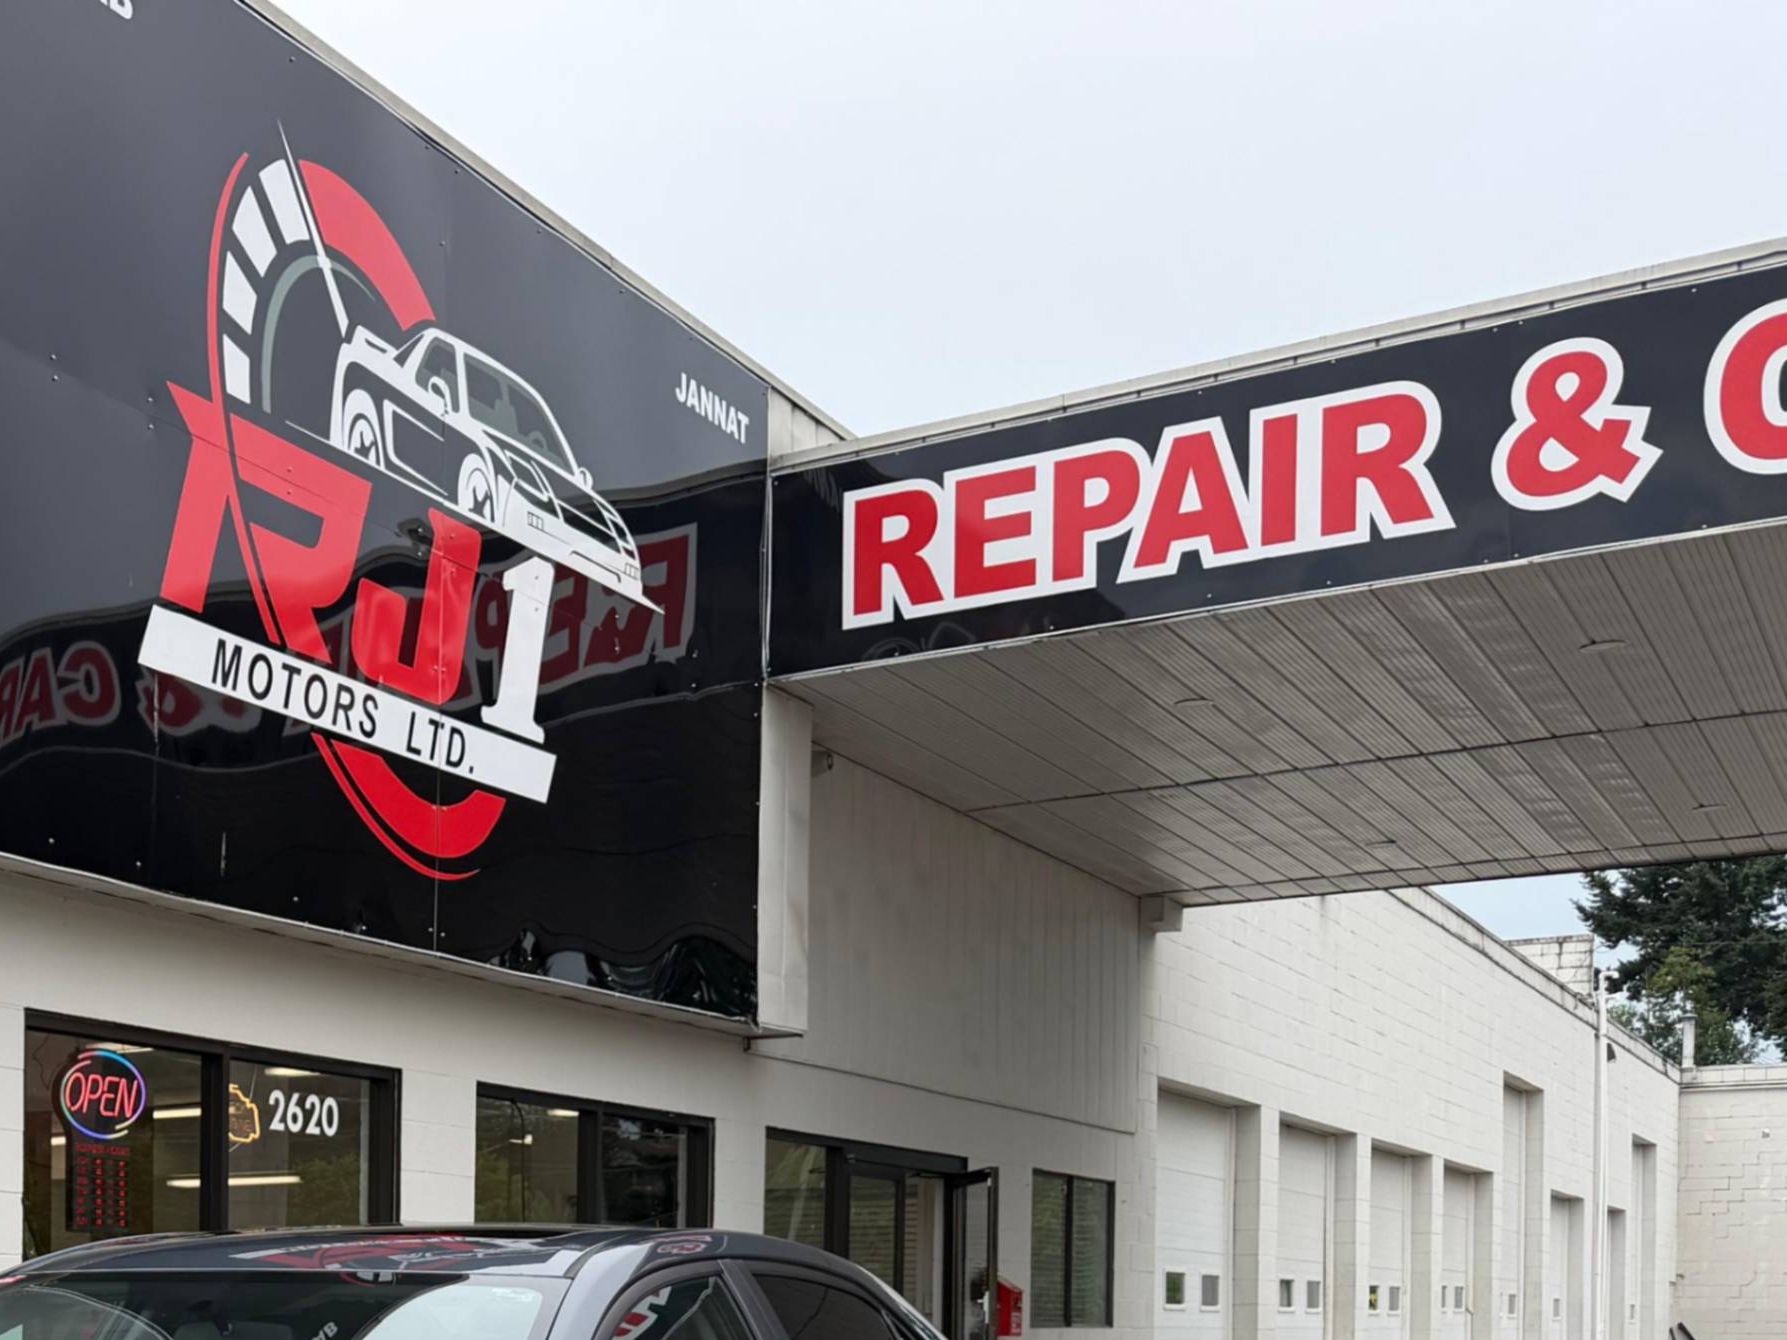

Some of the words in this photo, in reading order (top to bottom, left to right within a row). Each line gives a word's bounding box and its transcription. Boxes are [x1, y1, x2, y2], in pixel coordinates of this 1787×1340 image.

[674, 371, 750, 446] JANNAT
[842, 379, 1457, 631] REPAIR
[1490, 336, 1664, 512] &
[160, 380, 557, 744] RJ1
[210, 637, 380, 739] MOTORS
[405, 702, 476, 774] LTD.
[65, 1071, 138, 1119] OPEN
[268, 1088, 340, 1138] 2620
